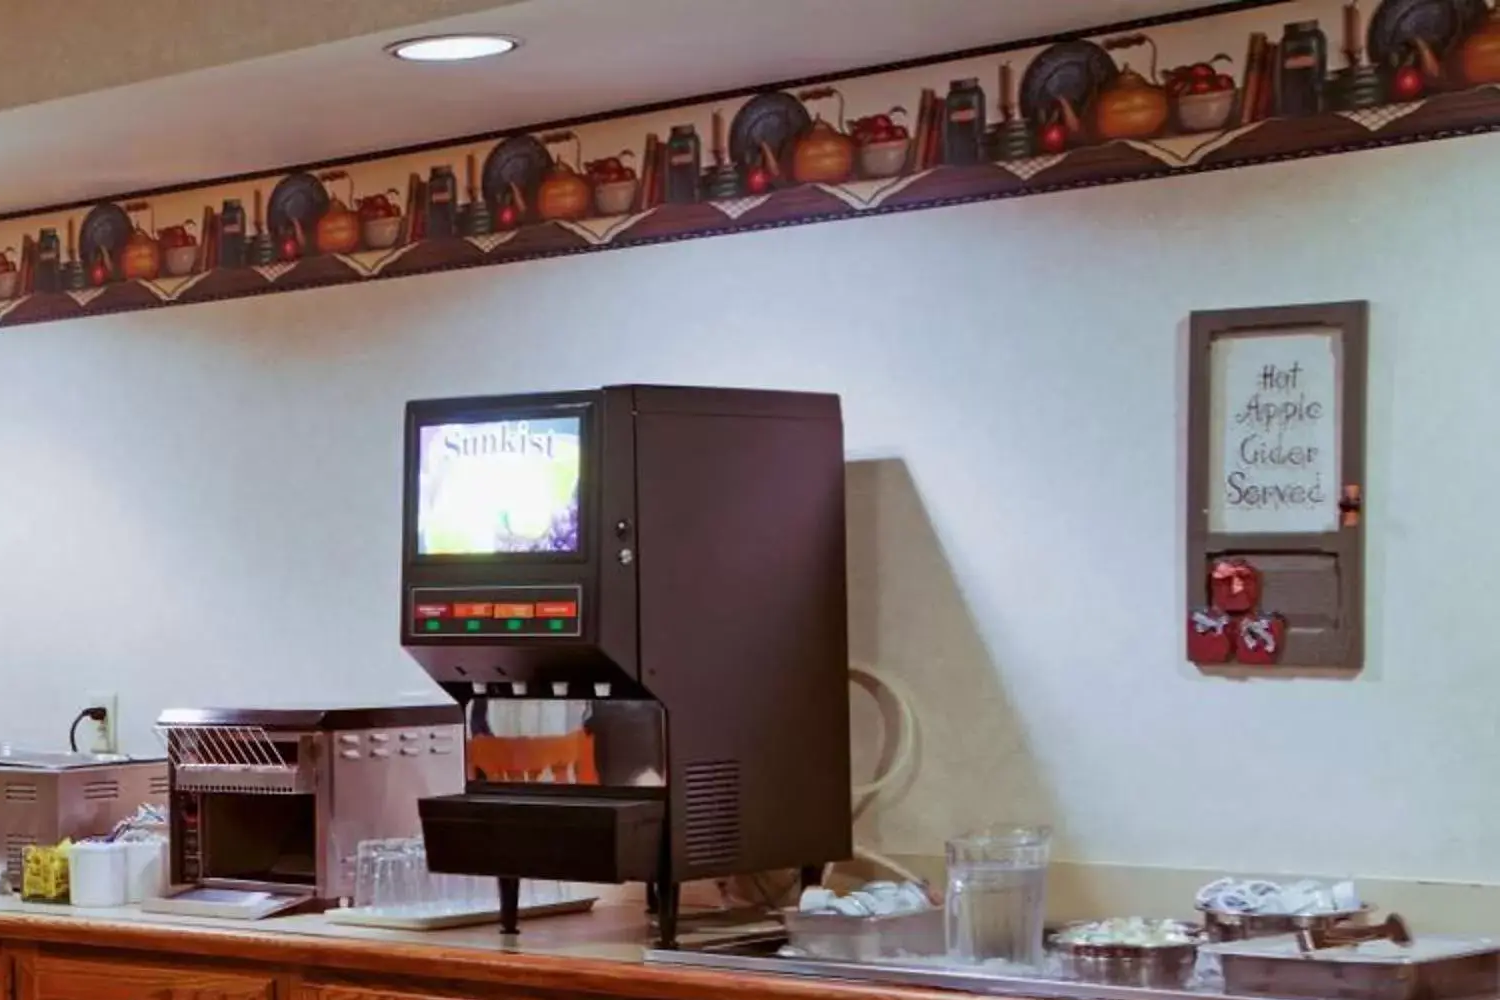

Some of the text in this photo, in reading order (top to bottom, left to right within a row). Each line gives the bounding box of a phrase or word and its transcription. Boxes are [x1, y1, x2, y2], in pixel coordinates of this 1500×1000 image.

[1235, 394, 1323, 431] Apple
[444, 422, 555, 458] Sunkist
[1240, 432, 1319, 464] Cider
[1227, 471, 1324, 505] Served
